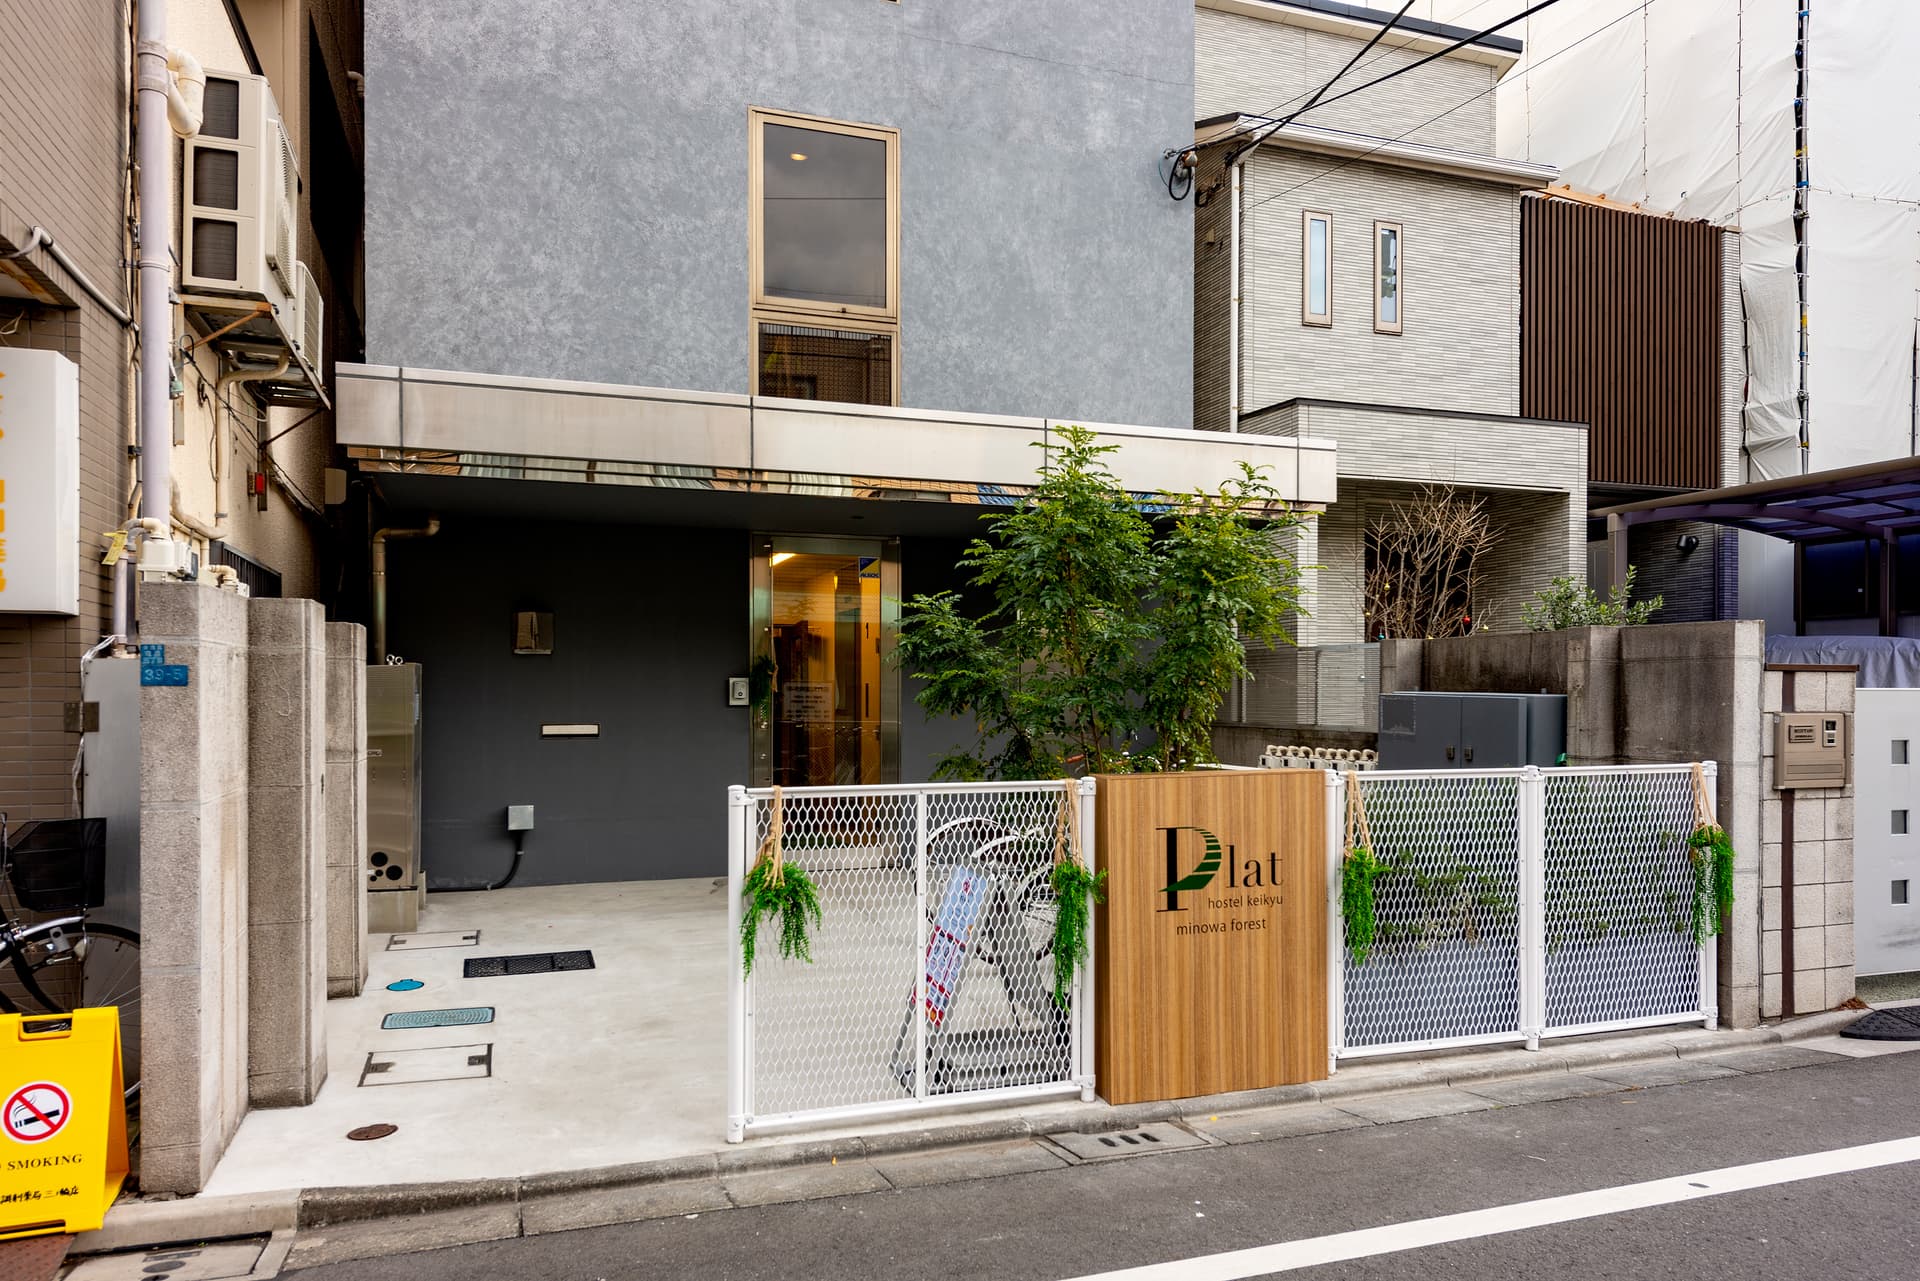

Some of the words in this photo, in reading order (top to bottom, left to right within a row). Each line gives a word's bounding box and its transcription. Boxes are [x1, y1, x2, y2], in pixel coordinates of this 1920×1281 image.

[144, 668, 182, 681] 39-5
[1155, 826, 1284, 912] Plat
[1208, 896, 1243, 909] hostel
[1247, 894, 1283, 909] keikyu
[1176, 920, 1227, 935] minowa
[1231, 918, 1267, 932] forest
[7, 1153, 82, 1171] SMOKING
